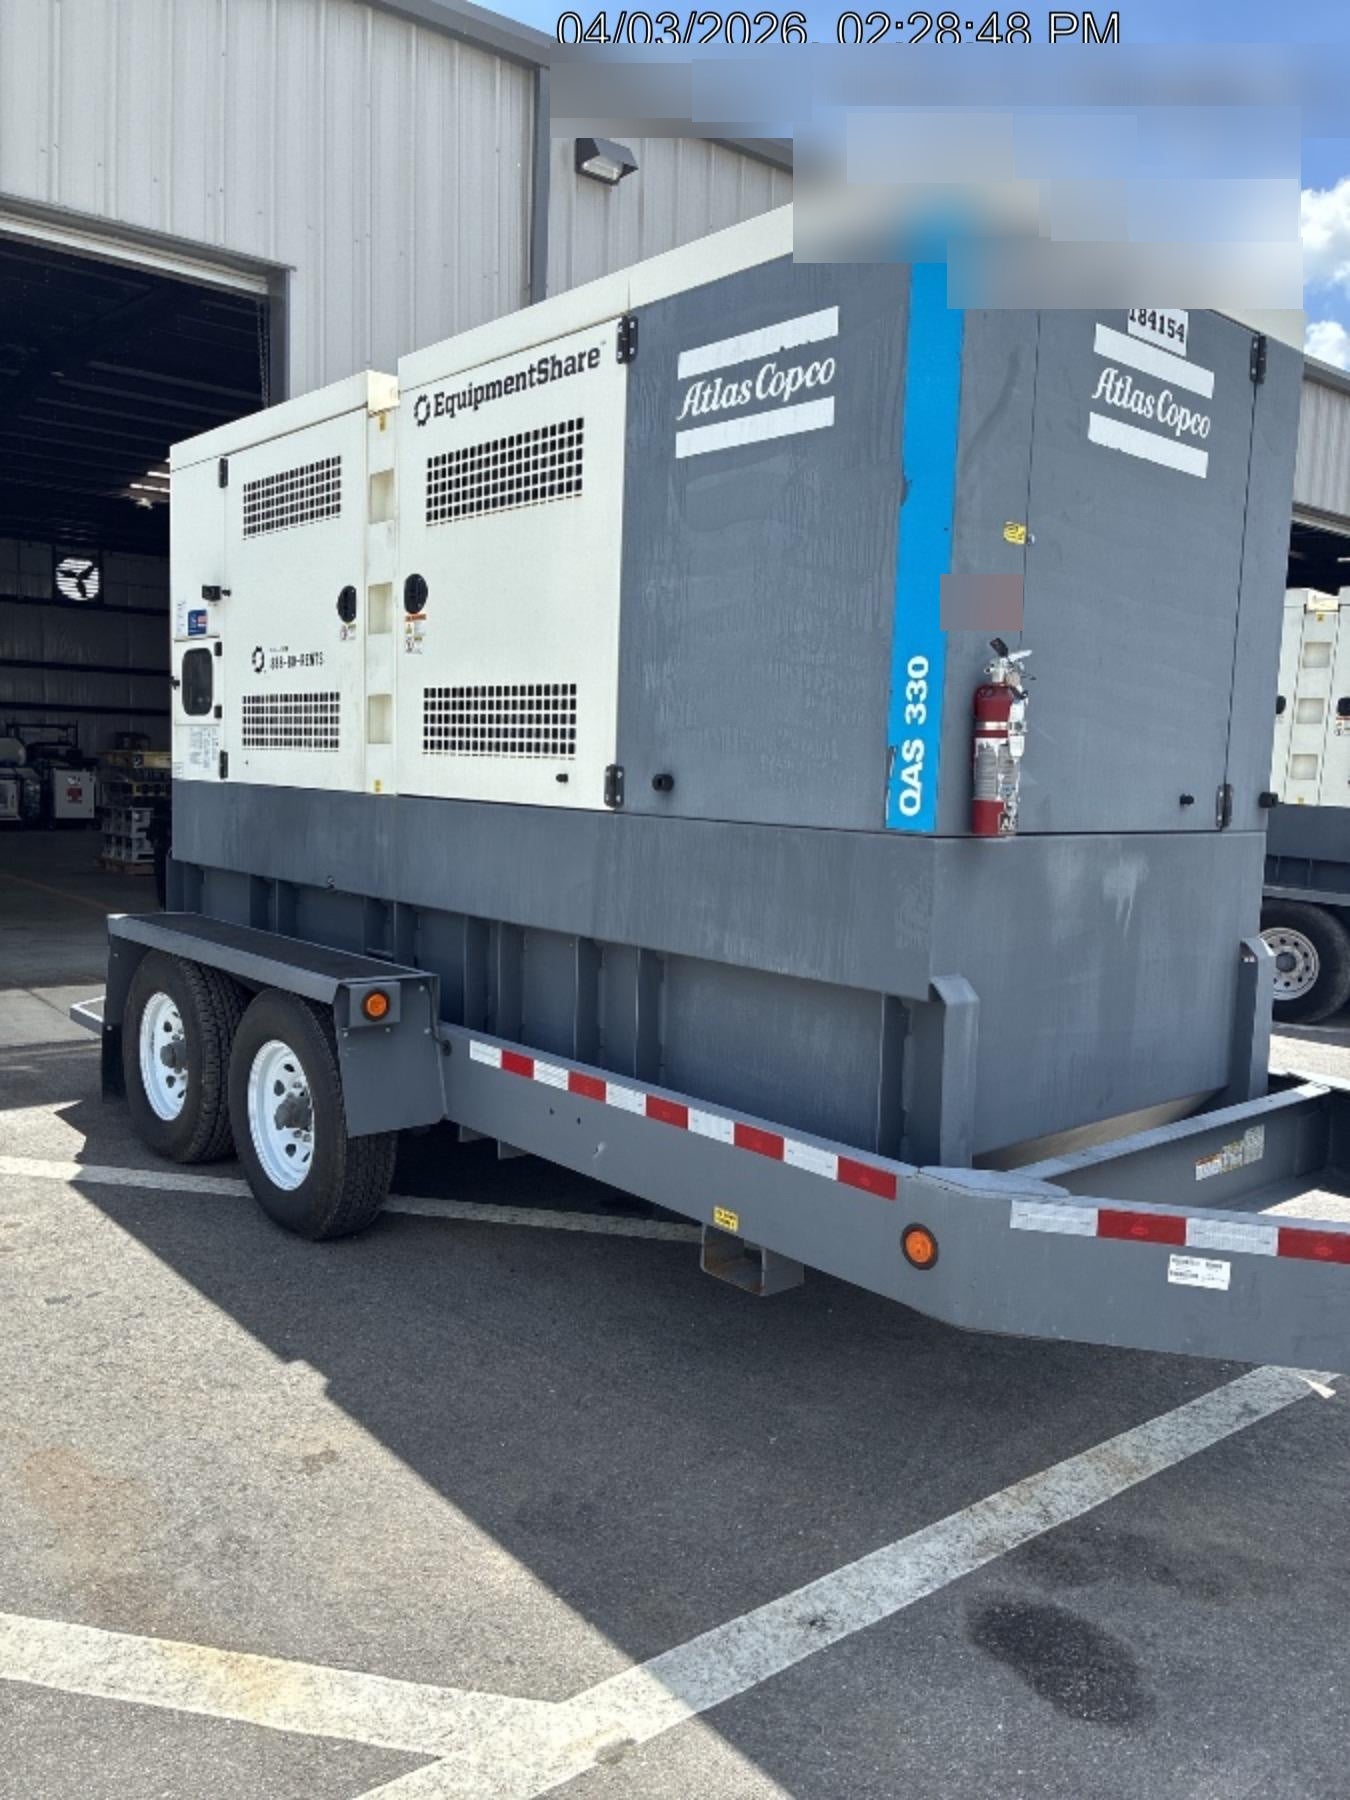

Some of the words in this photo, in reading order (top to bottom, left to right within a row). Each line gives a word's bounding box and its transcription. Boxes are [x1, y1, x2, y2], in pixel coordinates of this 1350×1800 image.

[1129, 309, 1185, 343] 184154
[433, 347, 601, 418] EquipmentShare
[676, 377, 753, 421] Atlas
[755, 357, 835, 402] Copco
[1091, 367, 1155, 419] Atlas
[1157, 389, 1211, 438] Copco
[904, 655, 929, 725] 330
[898, 738, 925, 816] QAS
